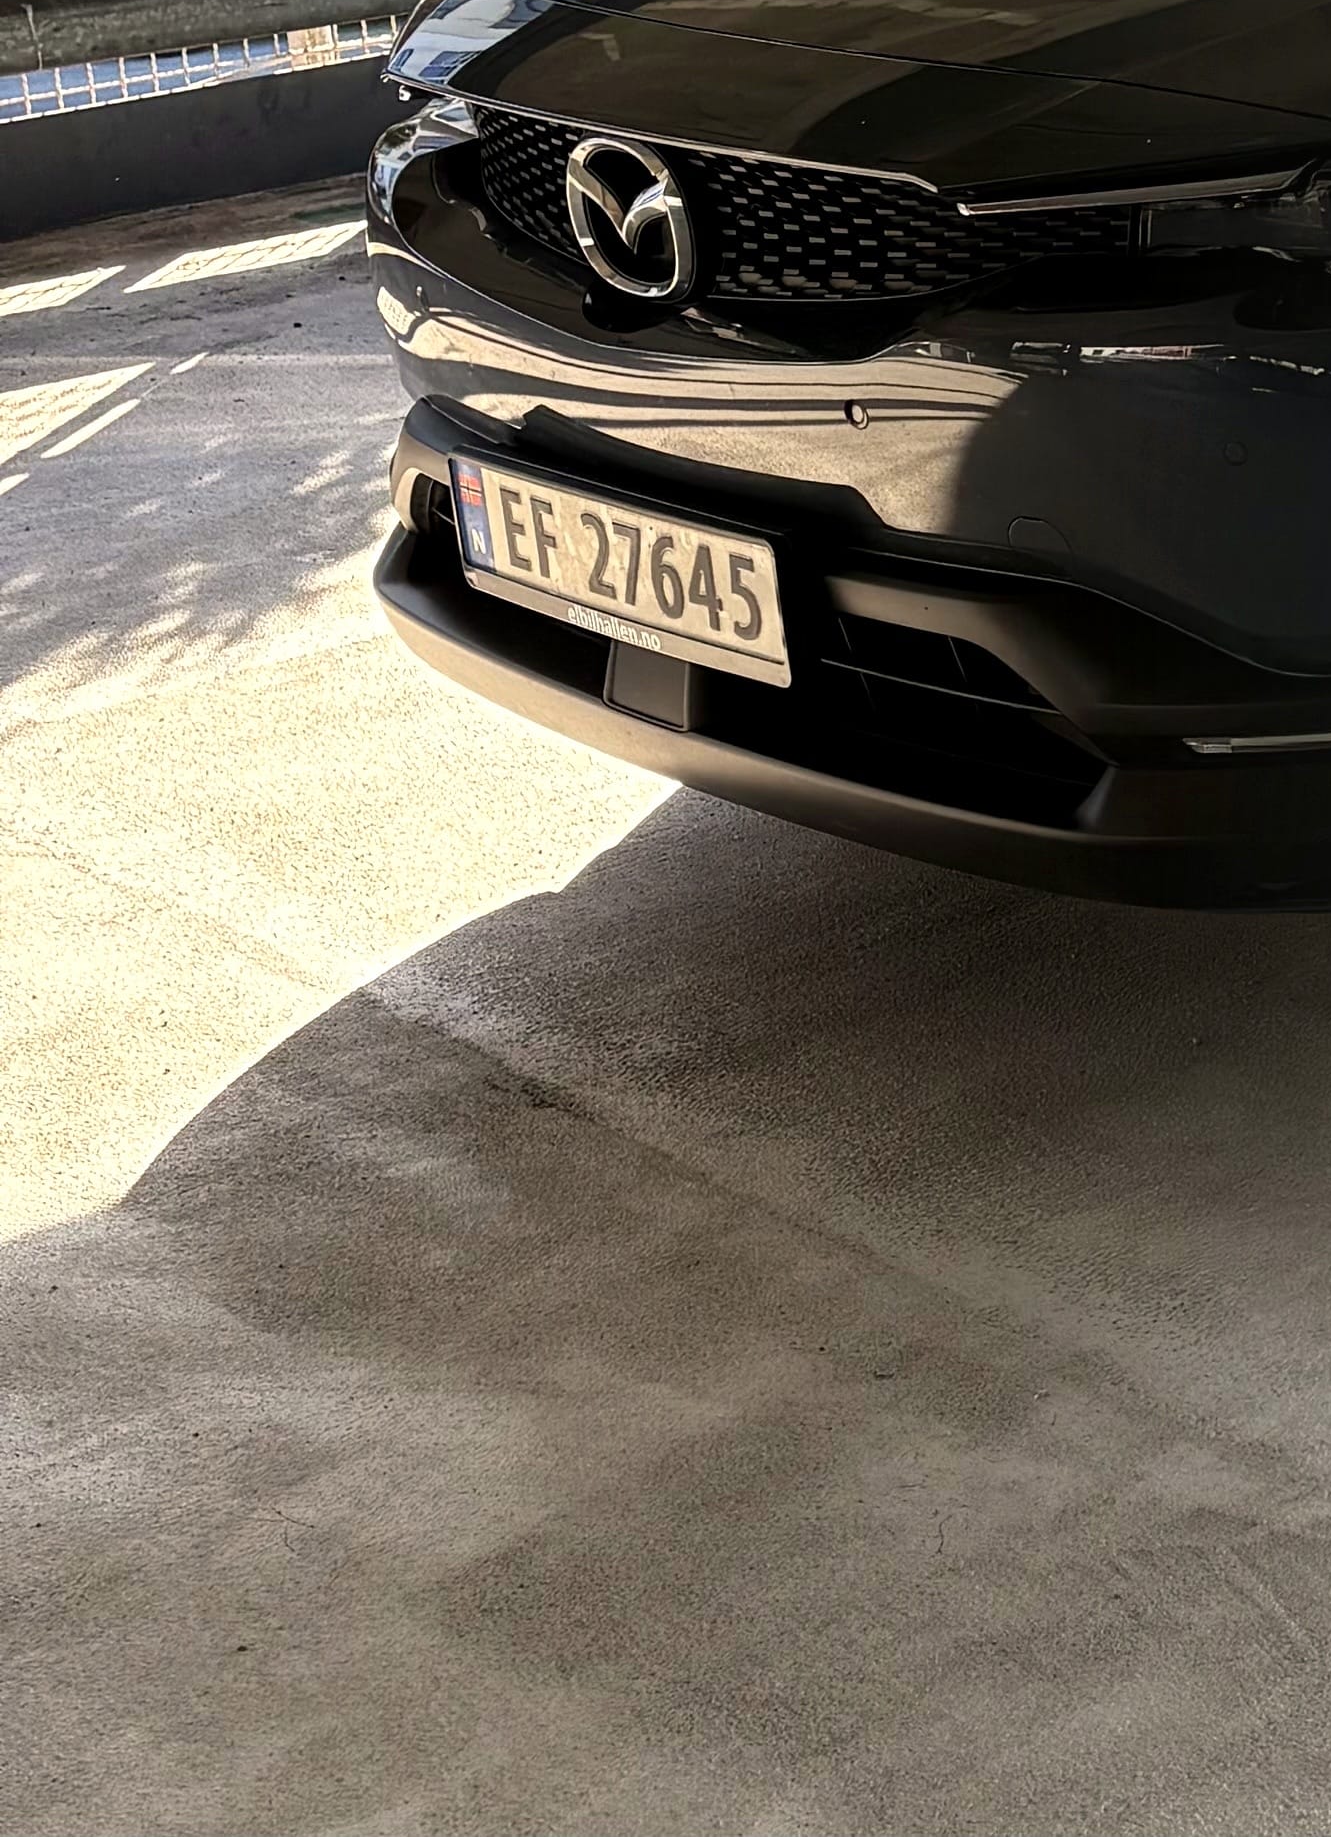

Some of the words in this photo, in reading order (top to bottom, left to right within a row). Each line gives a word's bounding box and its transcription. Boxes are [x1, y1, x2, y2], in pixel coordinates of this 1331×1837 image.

[471, 528, 487, 555] N
[500, 486, 557, 579] EF
[580, 512, 763, 641] 27645
[567, 603, 663, 652] elbilhallen.no
